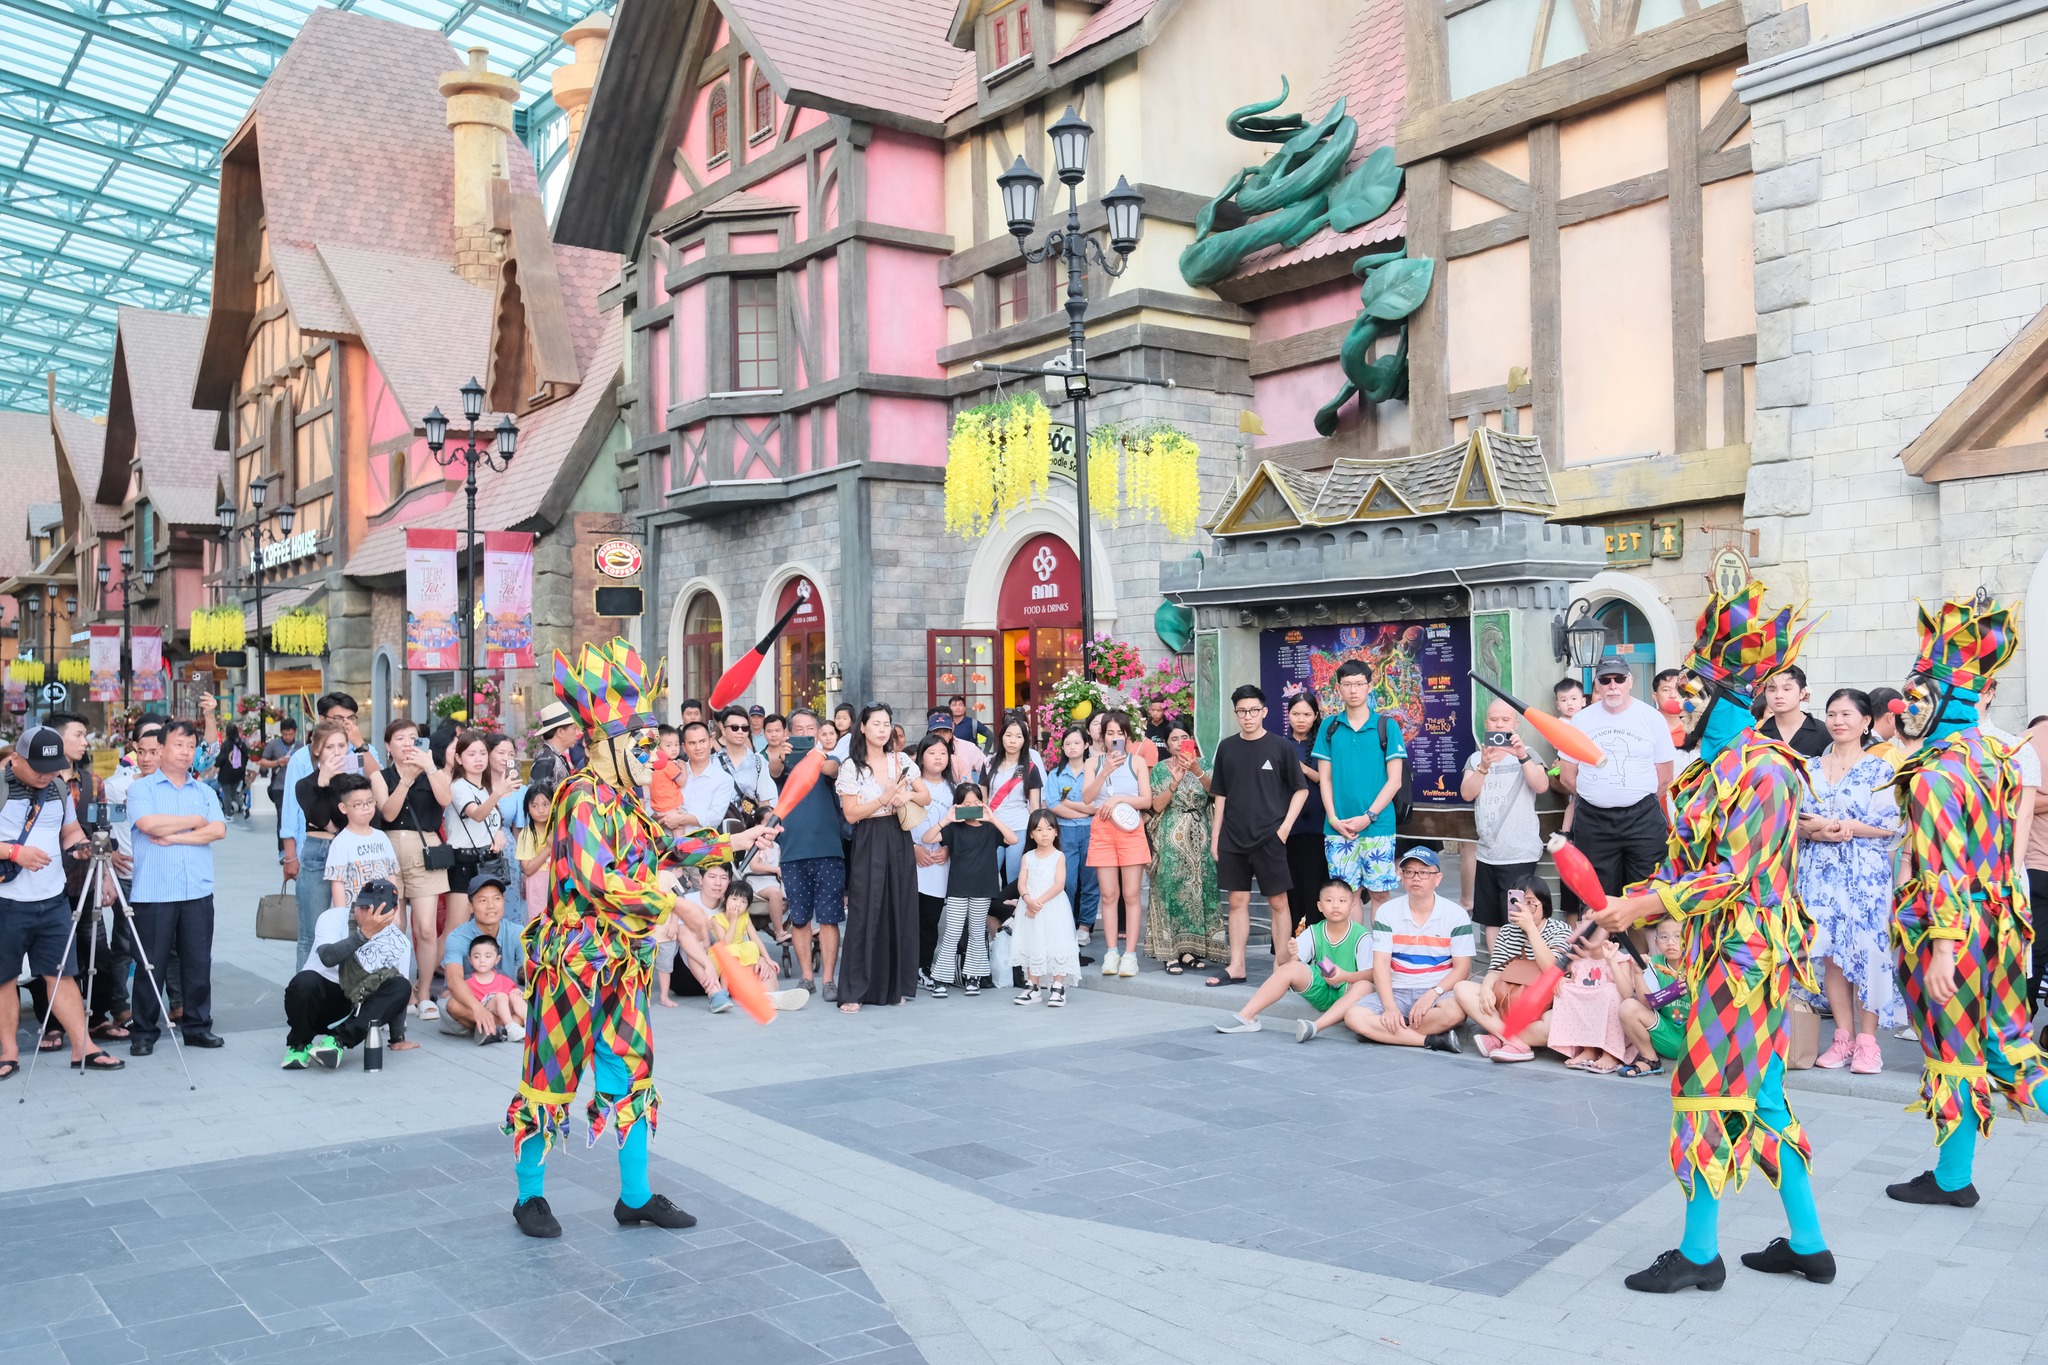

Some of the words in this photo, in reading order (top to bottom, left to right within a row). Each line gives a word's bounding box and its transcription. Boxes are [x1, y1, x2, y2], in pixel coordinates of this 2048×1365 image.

[263, 538, 291, 568] COFFEE
[291, 528, 317, 560] HOUSE
[599, 542, 640, 558] HIGHLANDS
[604, 566, 635, 576] COFFEE
[1023, 606, 1041, 615] FOOD
[1041, 604, 1047, 613] &
[1047, 603, 1069, 613] DRINKS
[1423, 789, 1457, 797] VinWonders
